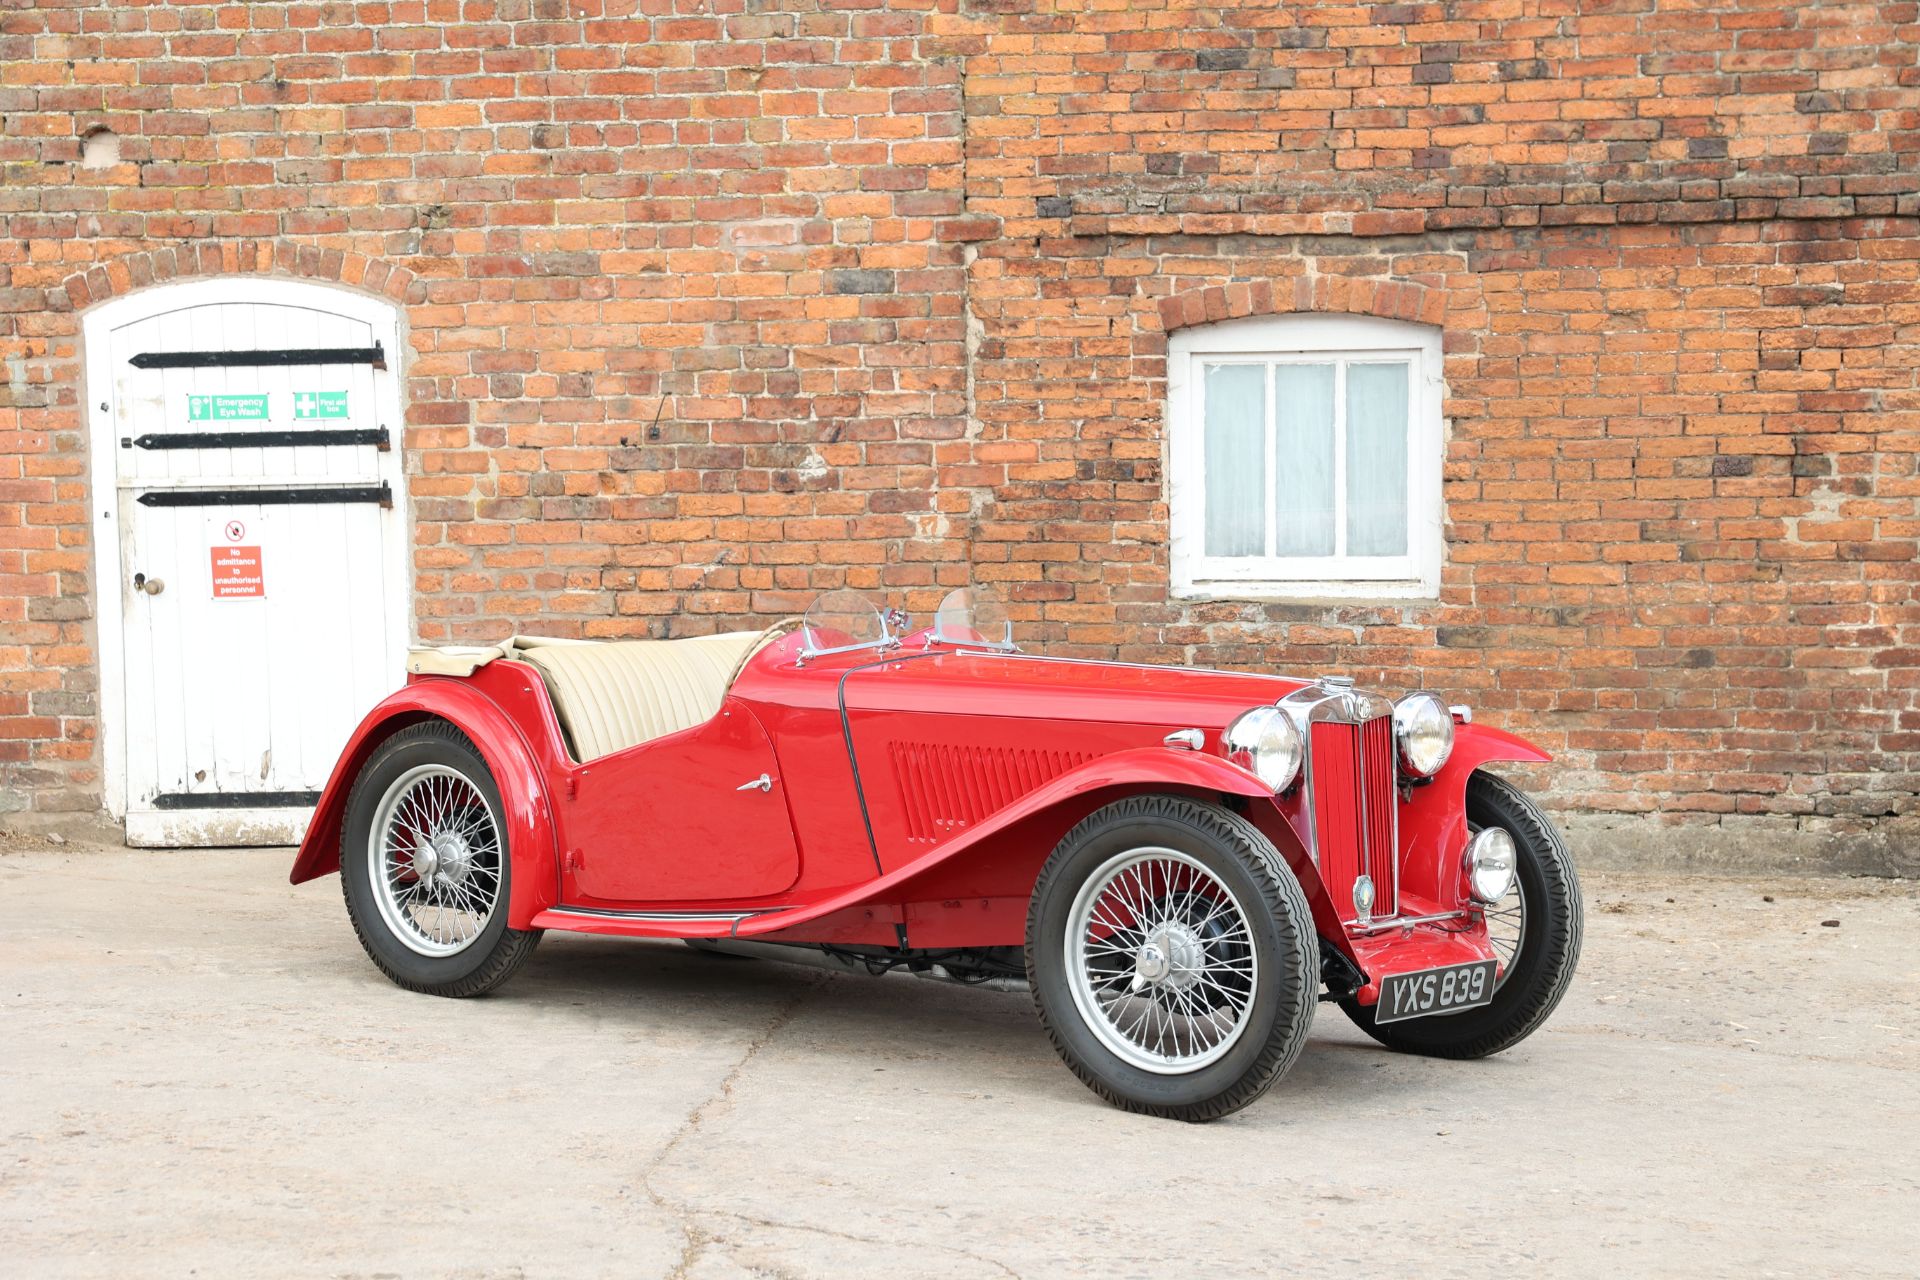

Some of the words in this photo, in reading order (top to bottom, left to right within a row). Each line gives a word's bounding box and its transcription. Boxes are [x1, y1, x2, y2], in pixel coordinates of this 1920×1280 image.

[216, 398, 264, 407] Emergency
[220, 408, 236, 417] Eye
[238, 408, 262, 416] Wash
[217, 558, 256, 566] admittance
[221, 586, 256, 594] personnel
[1393, 974, 1437, 1015] YXS
[1440, 966, 1486, 1006] 839
